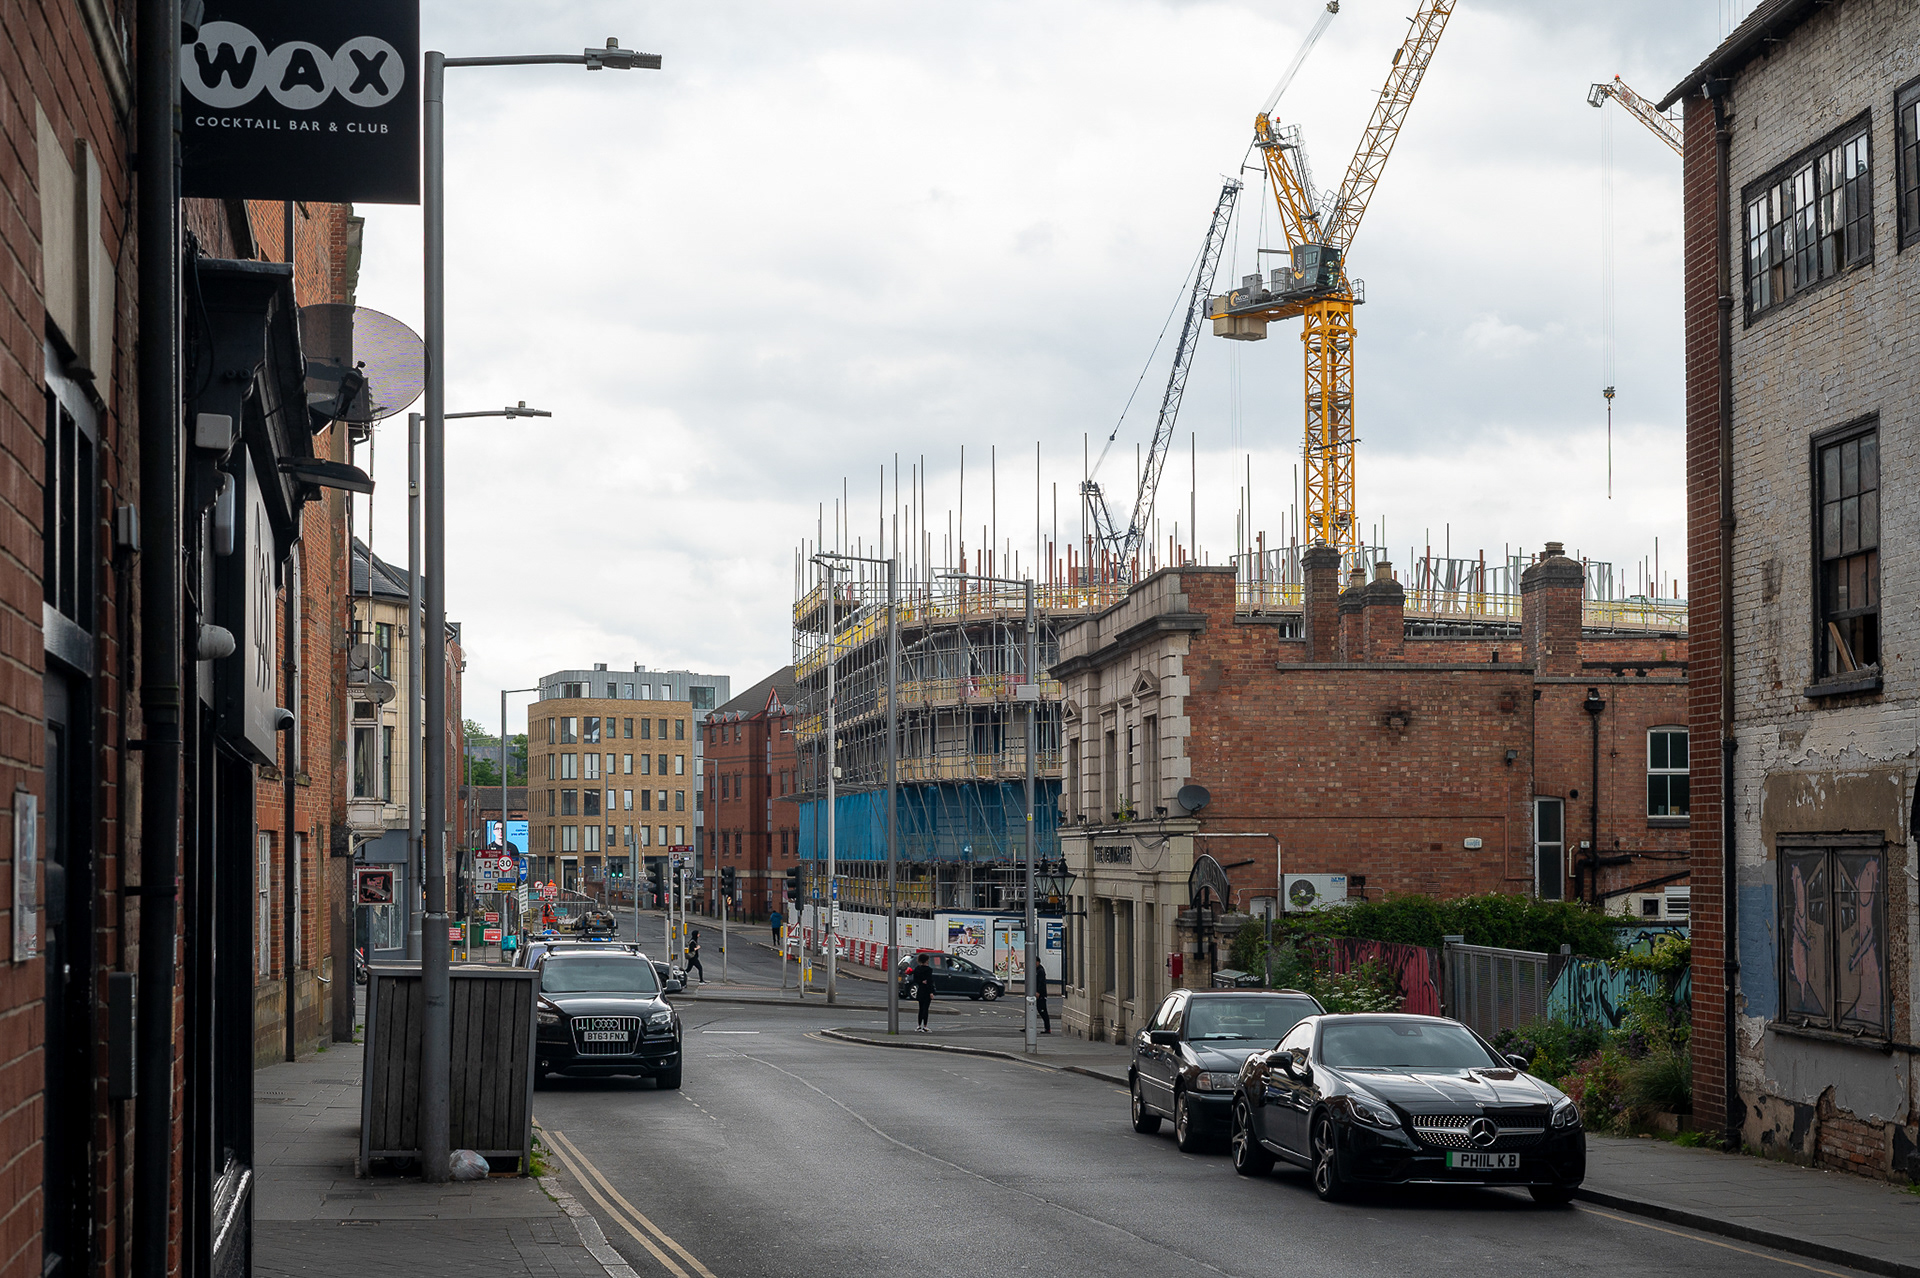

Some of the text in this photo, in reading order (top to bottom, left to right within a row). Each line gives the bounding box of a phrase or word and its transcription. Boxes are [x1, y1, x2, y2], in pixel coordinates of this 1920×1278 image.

[193, 42, 389, 96] WAX
[195, 116, 389, 134] COCKTAIL BAR & CLUB
[500, 859, 511, 867] 30
